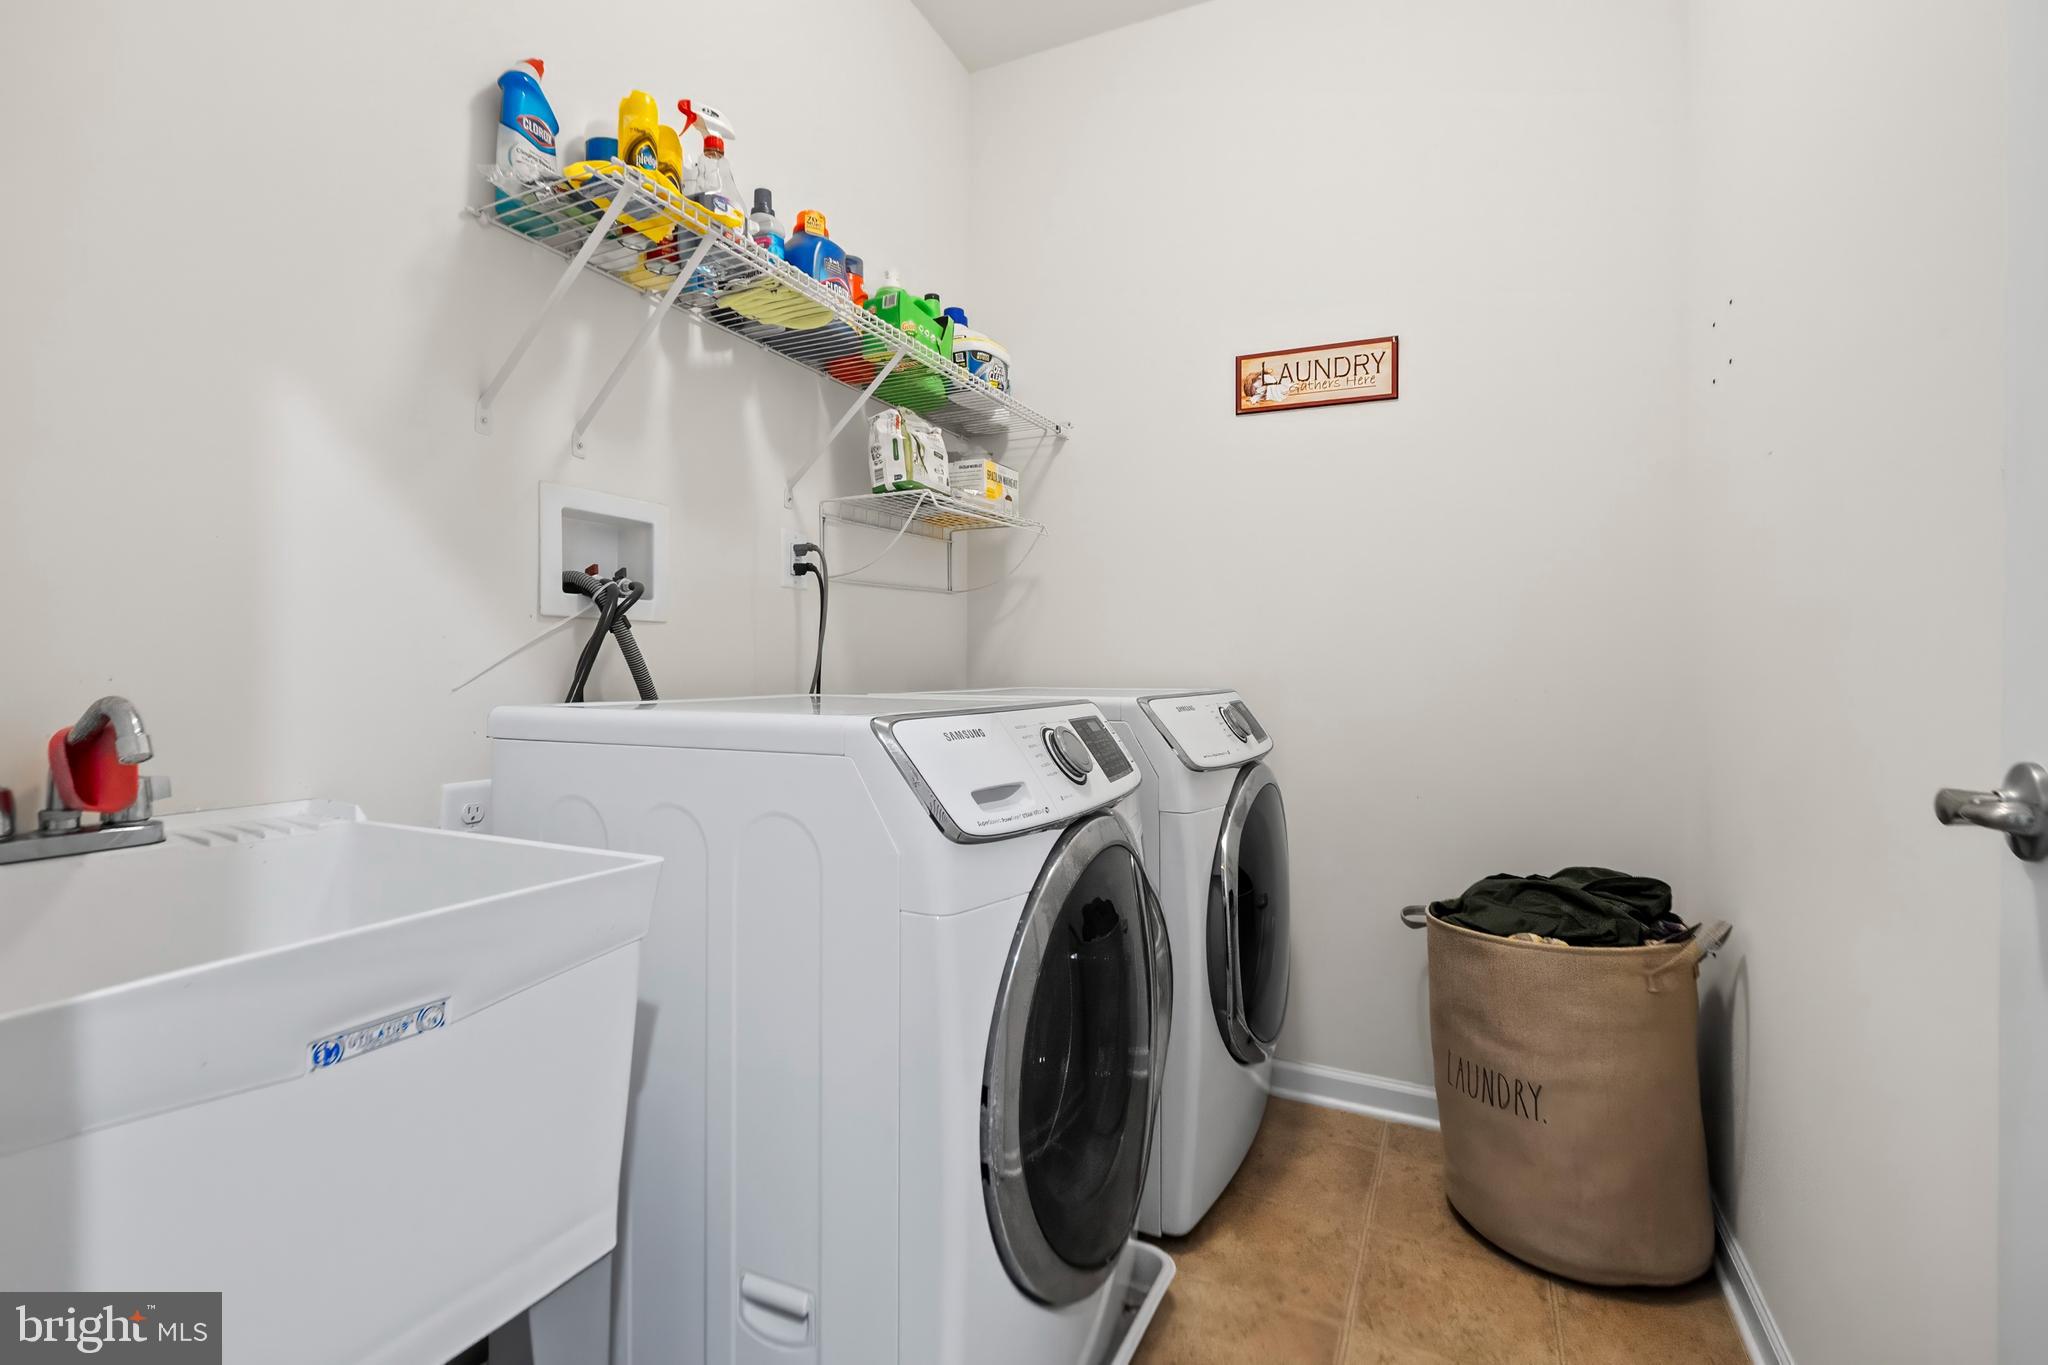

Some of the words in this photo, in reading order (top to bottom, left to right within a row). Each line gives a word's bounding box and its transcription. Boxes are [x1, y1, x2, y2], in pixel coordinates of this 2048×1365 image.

[522, 117, 552, 145] CLOROX
[1261, 351, 1386, 387] LAUNDRY
[1288, 380, 1341, 394] Gathers
[1346, 374, 1376, 387] Here
[943, 728, 986, 742] SAMSUNG
[1447, 1049, 1548, 1125] LAUNDRY.
